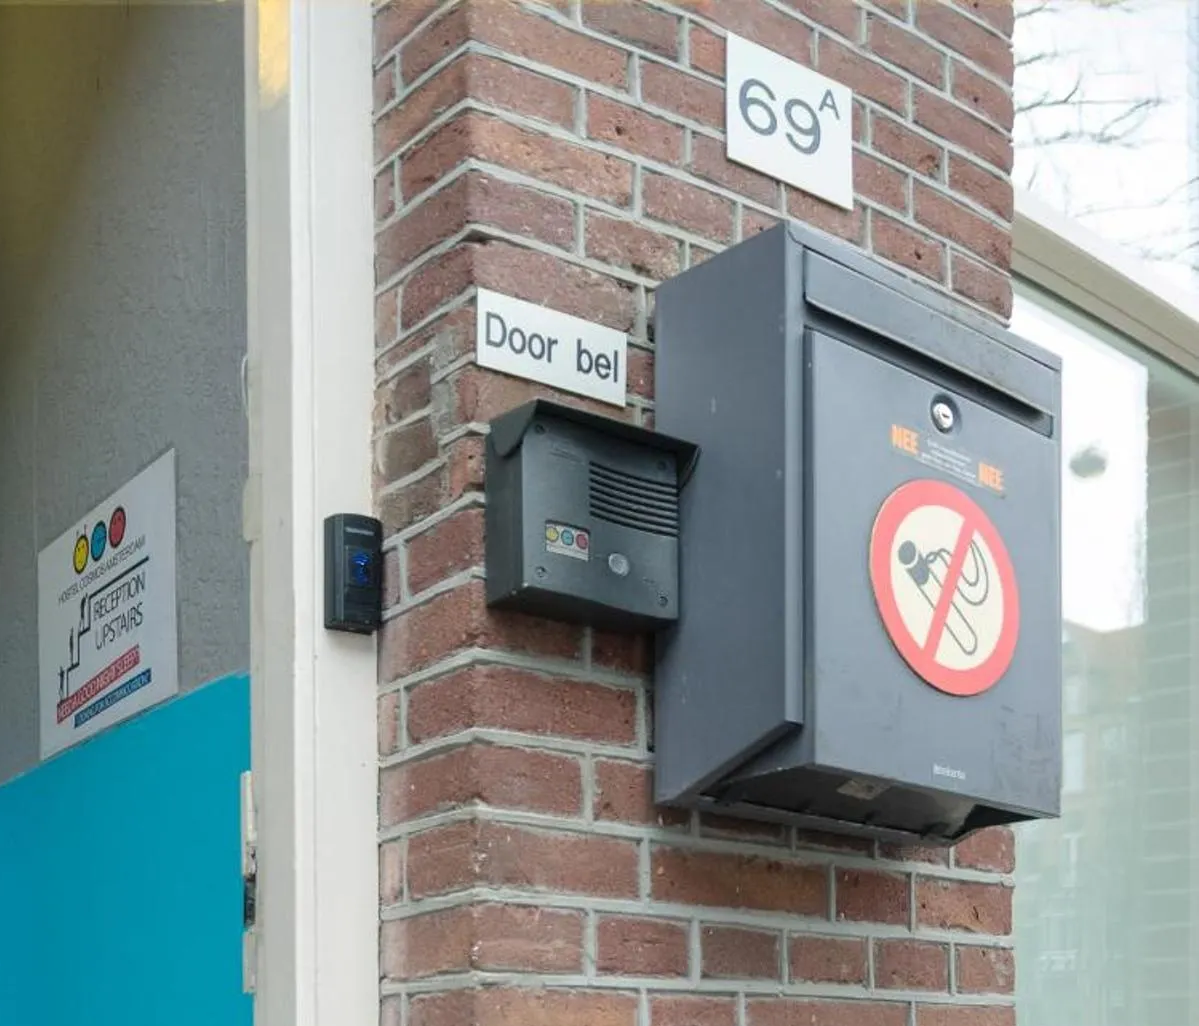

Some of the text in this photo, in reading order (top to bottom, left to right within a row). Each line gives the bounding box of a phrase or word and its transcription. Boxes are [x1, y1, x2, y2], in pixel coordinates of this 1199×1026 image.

[485, 311, 619, 384] Door bel
[891, 424, 919, 455] NEE
[979, 462, 1004, 491] NEE
[93, 571, 146, 622] RECEPTION
[95, 601, 144, 650] UPSTAIRS
